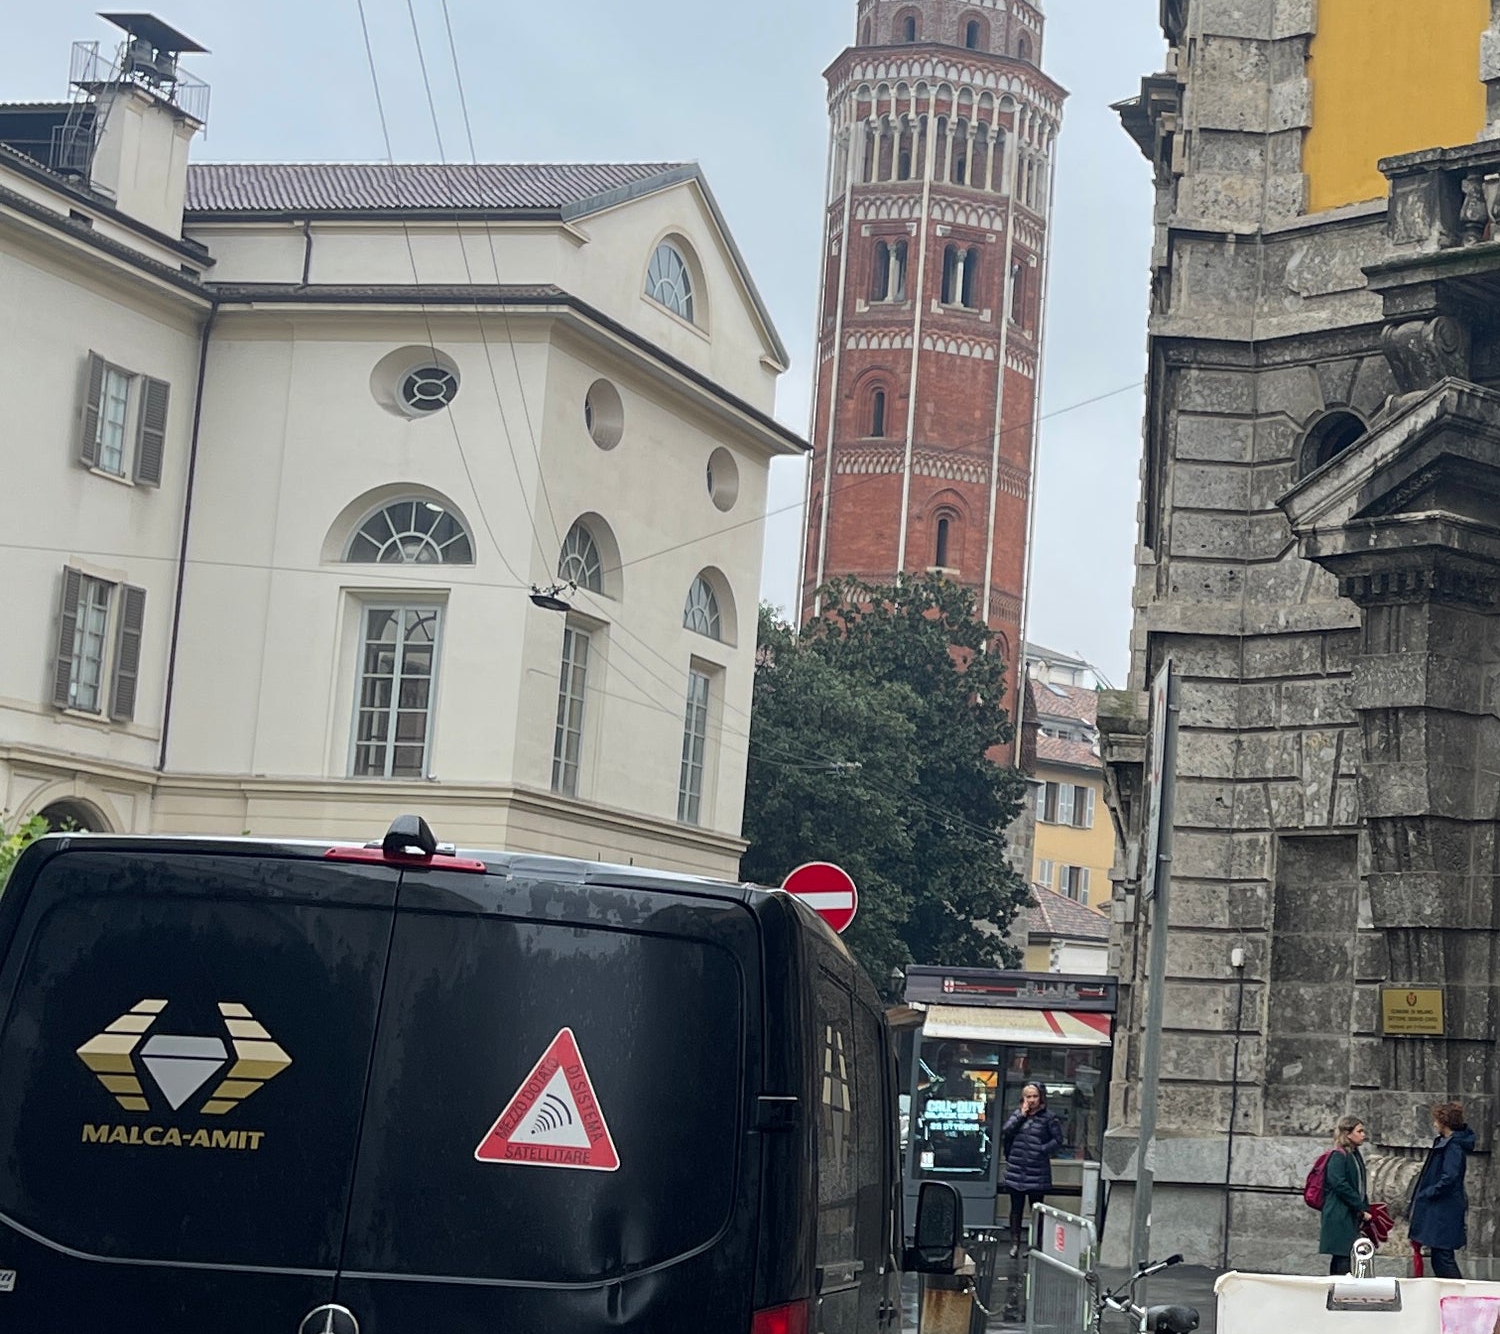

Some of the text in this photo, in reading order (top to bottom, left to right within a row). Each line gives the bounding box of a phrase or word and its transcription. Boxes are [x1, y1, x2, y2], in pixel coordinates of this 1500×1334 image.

[494, 1057, 560, 1139] MEZZO DOTATO
[566, 1064, 604, 1142] DI SISTEMA
[81, 1124, 265, 1150] MALCA-AMIT
[504, 1146, 591, 1165] SATELLITARE
